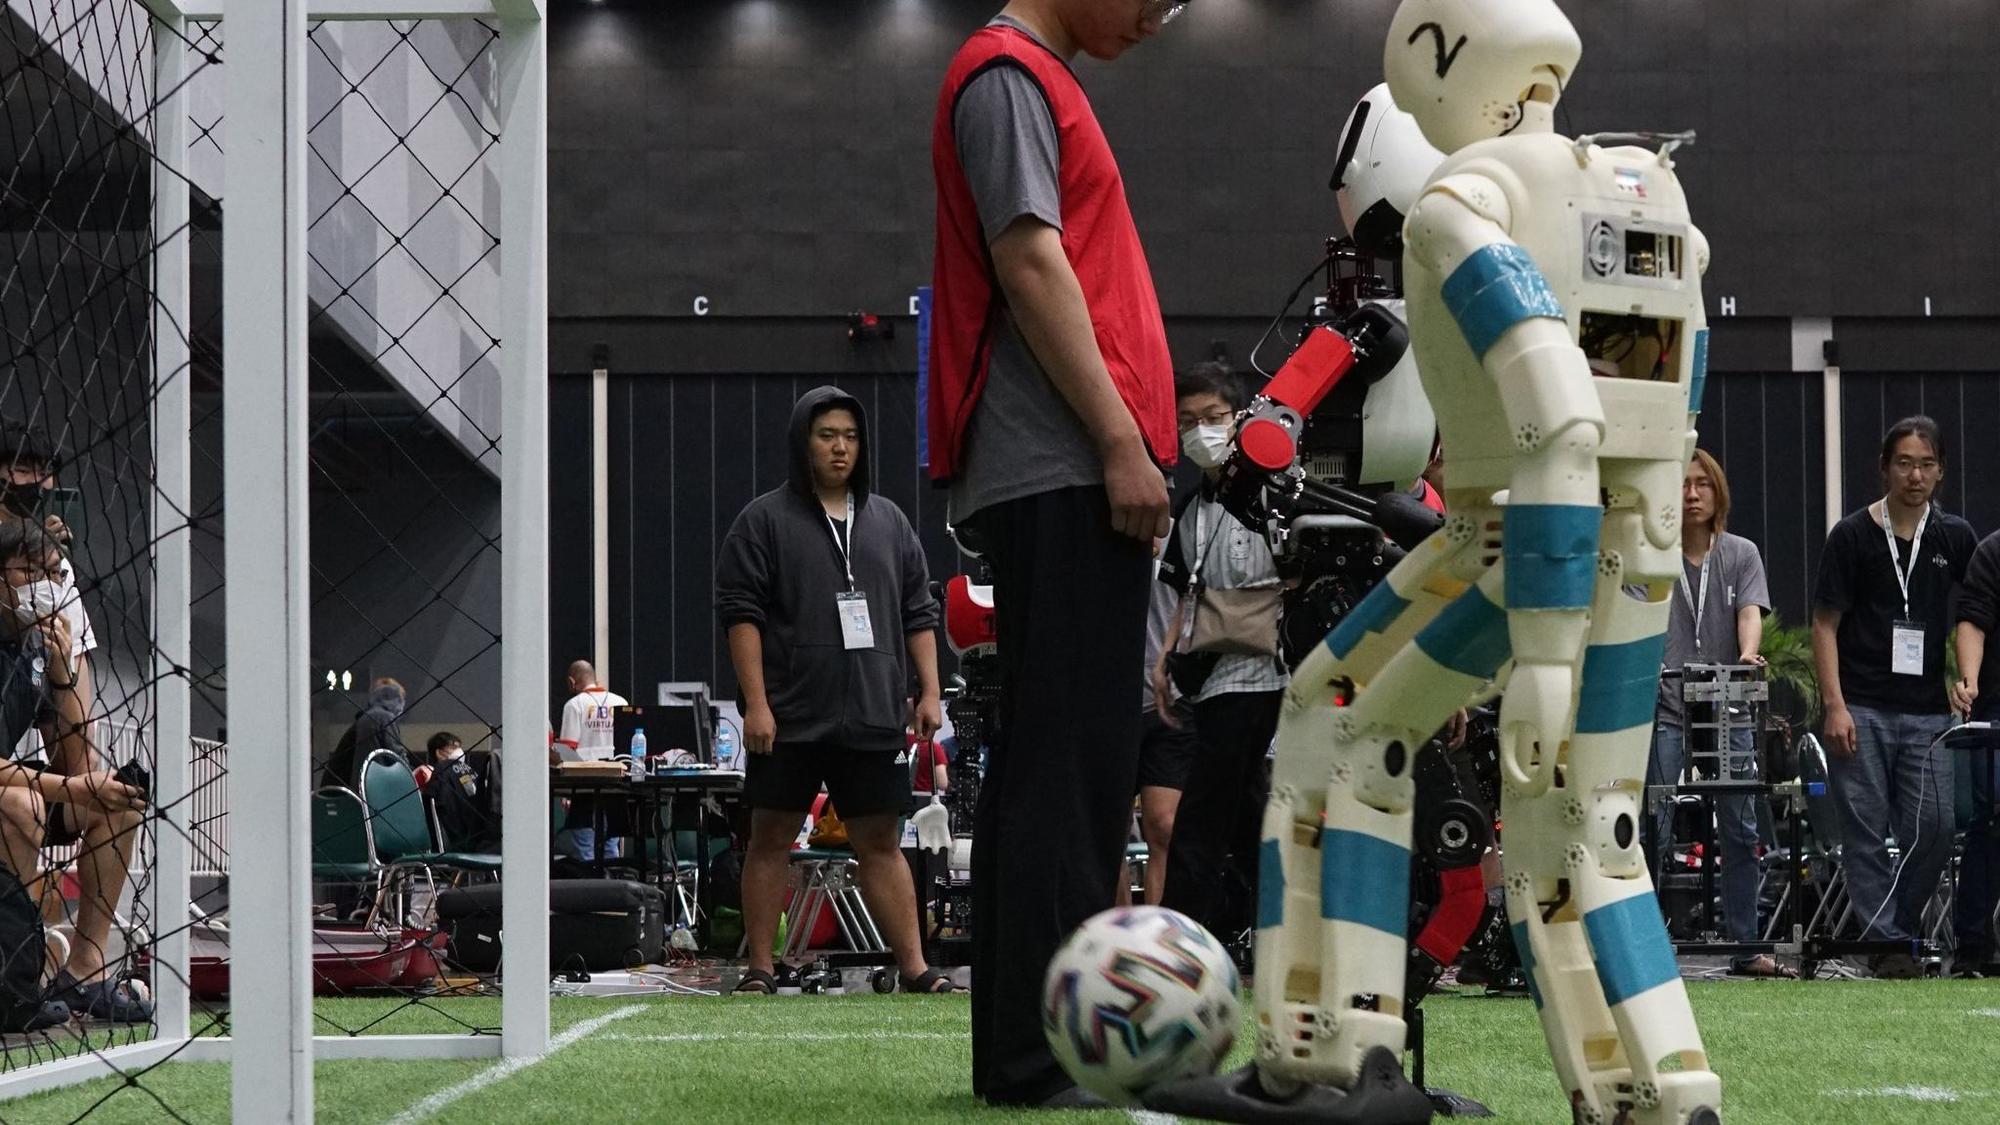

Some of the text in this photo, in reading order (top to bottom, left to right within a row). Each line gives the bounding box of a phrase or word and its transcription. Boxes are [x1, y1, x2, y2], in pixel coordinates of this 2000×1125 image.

[1408, 22, 1467, 79] 2
[694, 296, 708, 316] C
[1720, 297, 1736, 316] H
[1925, 297, 1931, 316] I
